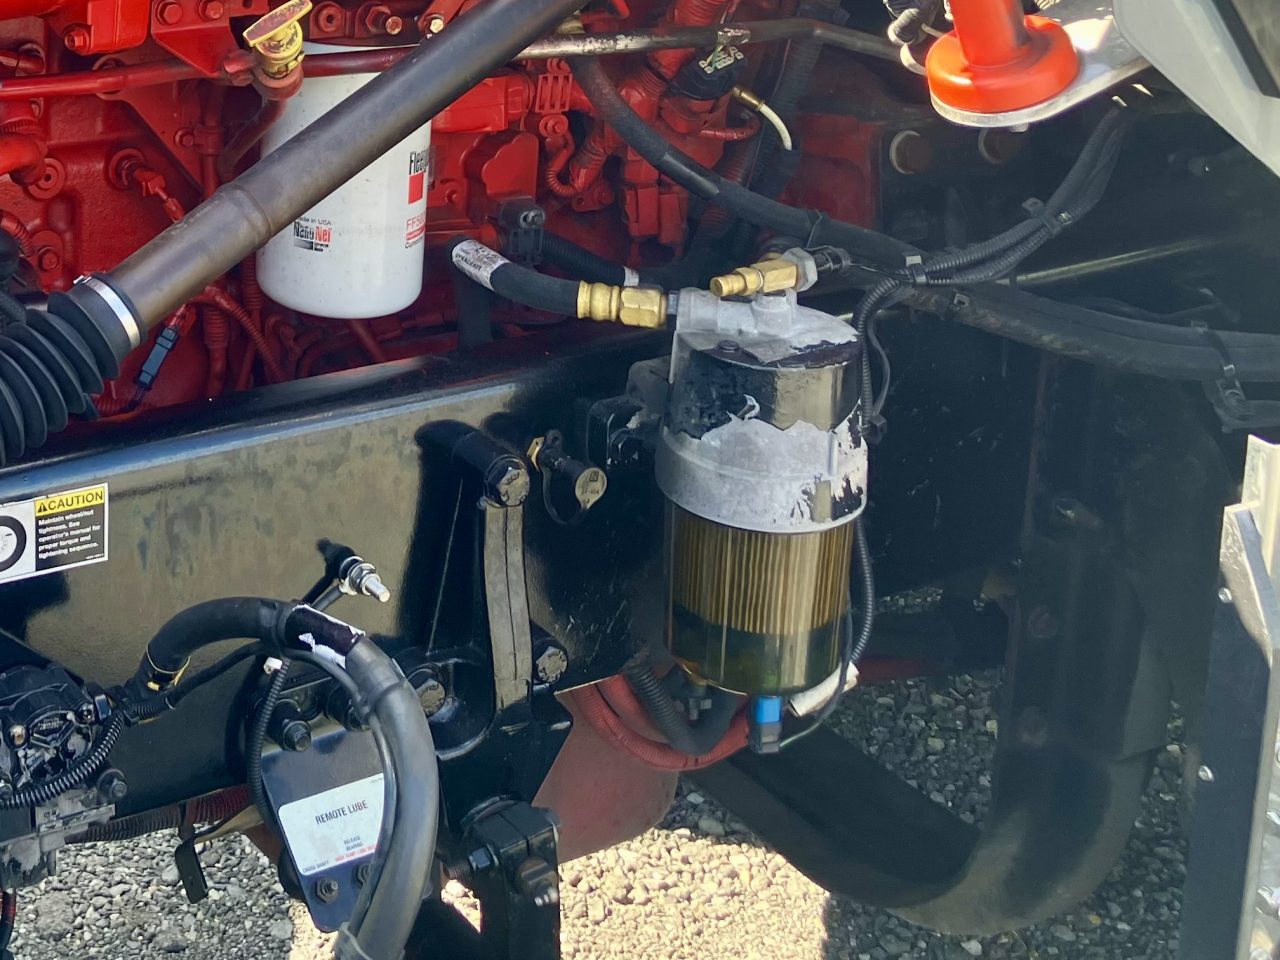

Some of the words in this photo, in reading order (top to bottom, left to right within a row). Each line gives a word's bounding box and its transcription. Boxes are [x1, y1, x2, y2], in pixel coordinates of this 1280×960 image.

[48, 491, 103, 510] CAUTION
[315, 806, 348, 824] REMOTE
[347, 799, 368, 814] LUBE
